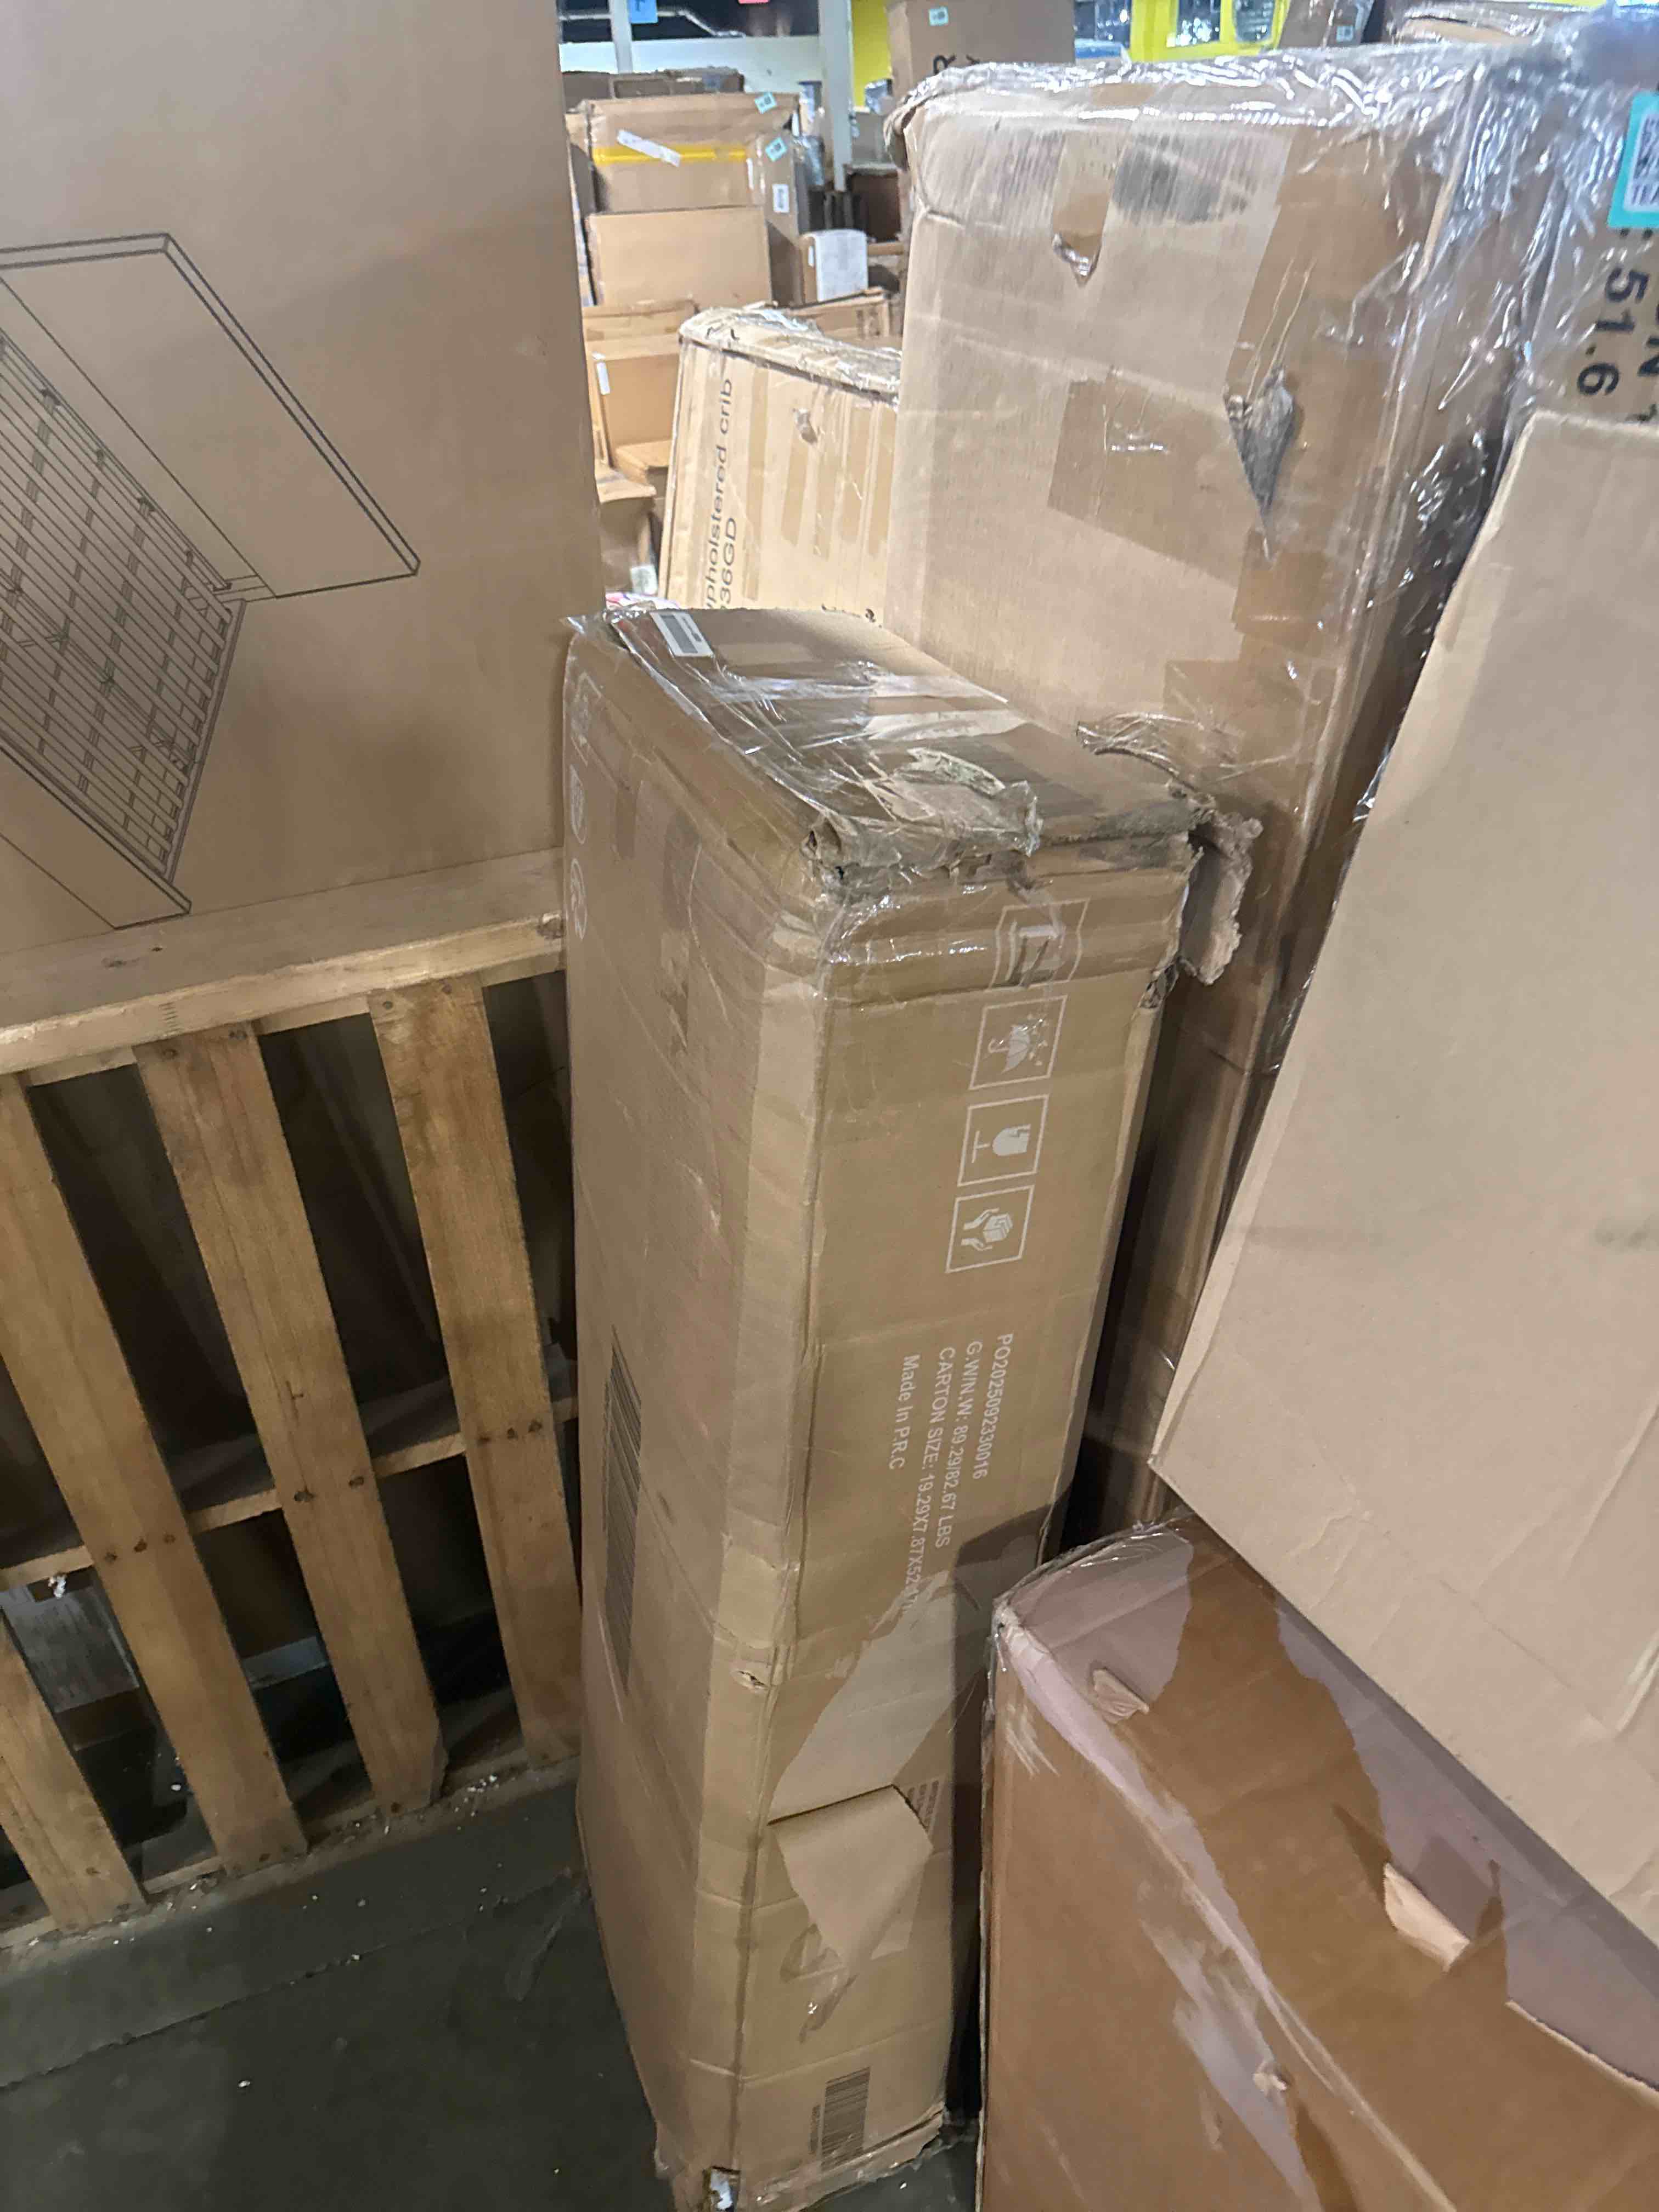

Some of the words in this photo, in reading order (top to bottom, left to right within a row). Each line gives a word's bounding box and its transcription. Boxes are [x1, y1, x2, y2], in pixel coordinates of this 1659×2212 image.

[718, 377, 733, 435] crib
[898, 1354, 920, 1402] Made
[929, 1347, 956, 1423] CARTON
[895, 1404, 913, 1424] In
[889, 1426, 910, 1470] P.R.C
[922, 1426, 943, 1471] SIZE:
[935, 1514, 952, 1549] LBS
